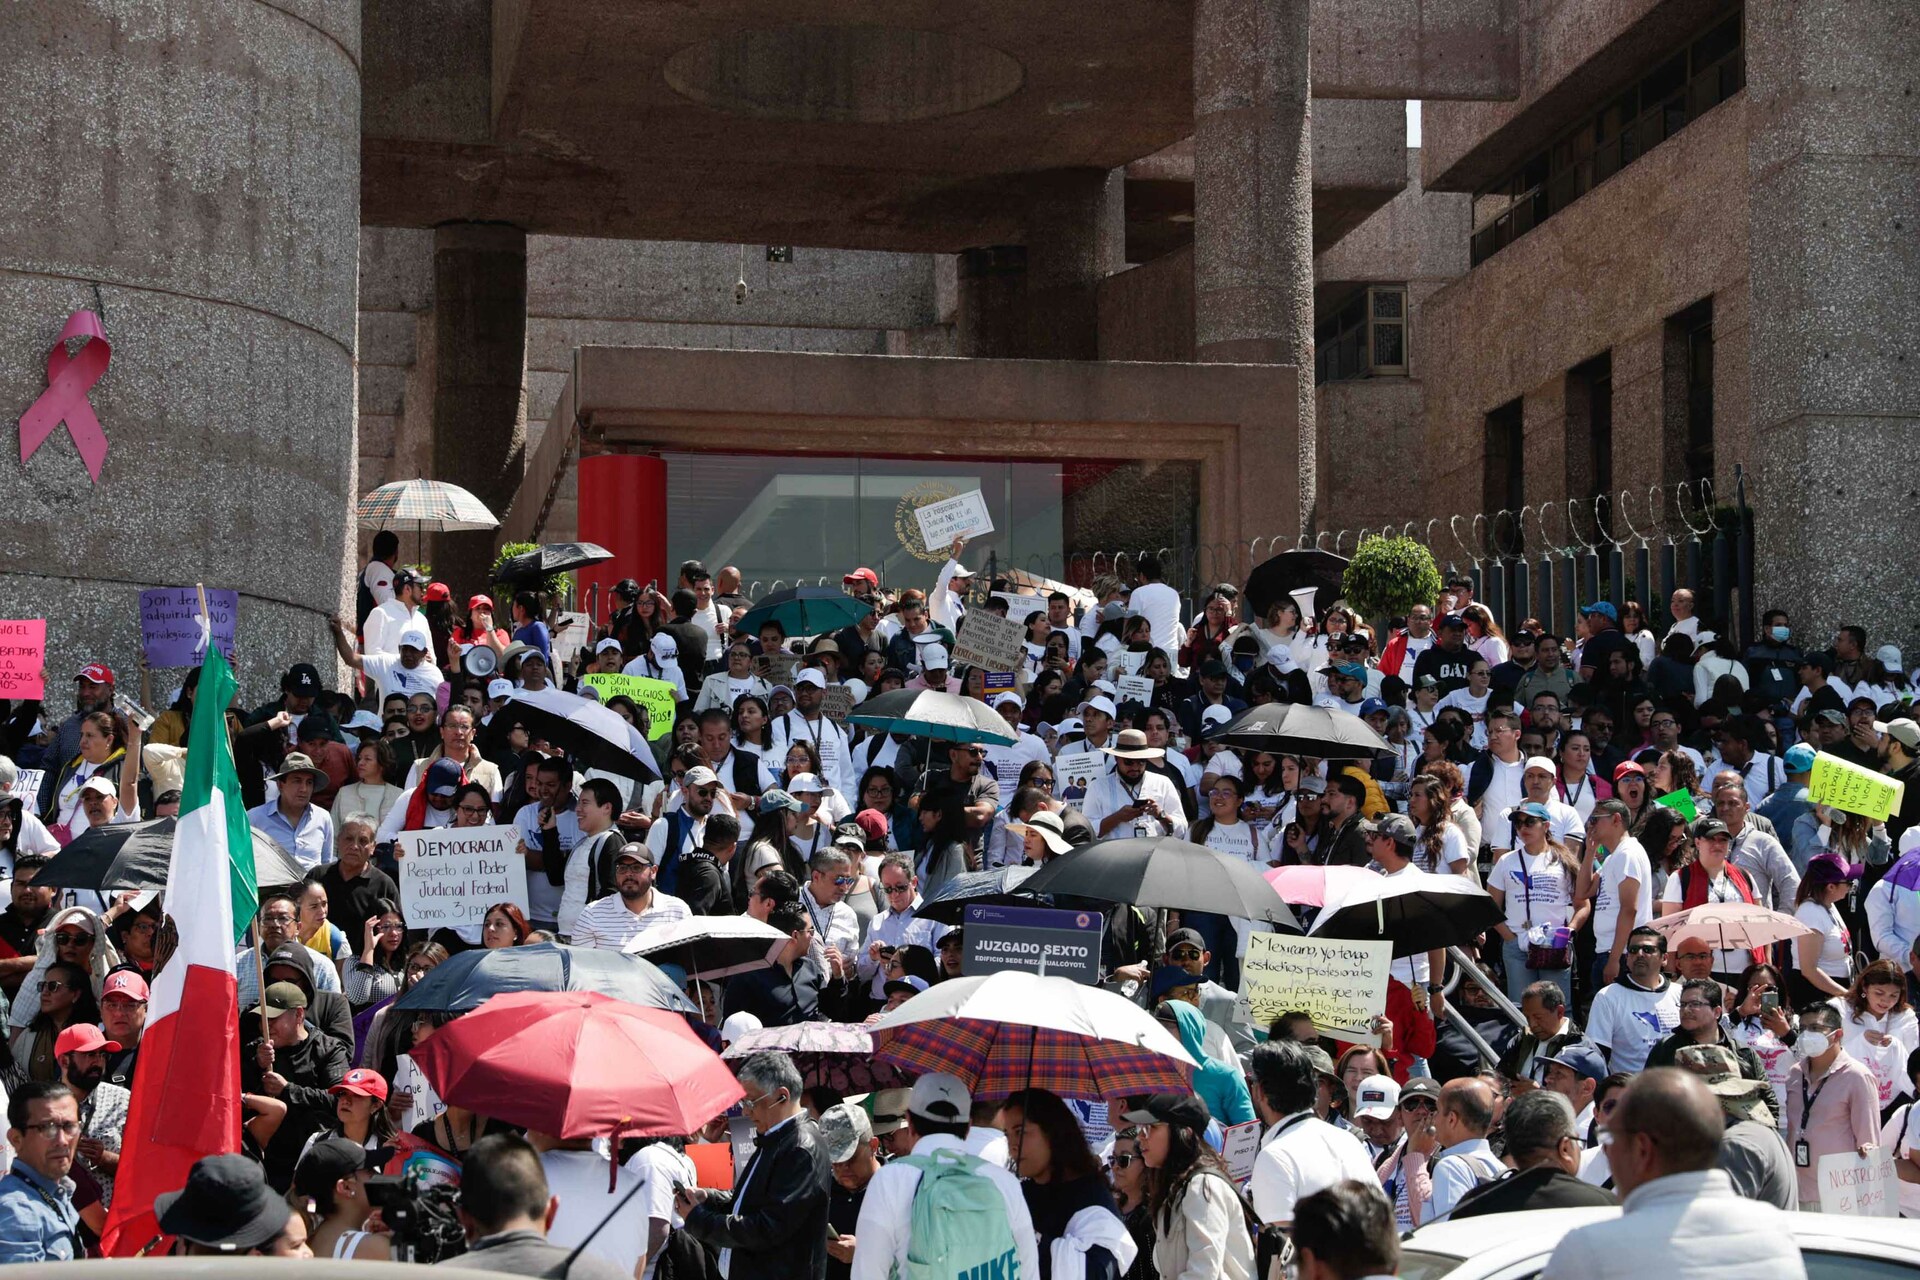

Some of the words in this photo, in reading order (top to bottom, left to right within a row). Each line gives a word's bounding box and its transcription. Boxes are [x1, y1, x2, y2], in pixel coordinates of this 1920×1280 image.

[945, 512, 955, 524] NO
[143, 592, 172, 609] Son
[210, 611, 228, 624] NO
[16, 625, 29, 635] EL
[953, 646, 983, 663] DERECHOS
[301, 673, 311, 685] LA
[591, 676, 606, 685] NO
[610, 675, 630, 686] SON
[416, 838, 504, 857] DEMOCRACIA
[407, 861, 457, 881] Respeto
[462, 861, 473, 875] al
[479, 860, 508, 875] Poder
[419, 880, 465, 898] Judicial
[472, 877, 508, 895] Federal
[452, 902, 465, 918] 3
[975, 939, 1040, 954] JUZGADO
[1043, 943, 1088, 958] SEXTO
[1336, 945, 1369, 967] tengo
[975, 955, 1004, 963] EDIFICIO
[1005, 957, 1023, 965] SEDE
[1246, 959, 1304, 975] estudios
[1307, 963, 1373, 981] profesionales
[1259, 996, 1289, 1007] casa
[1294, 999, 1311, 1008] en
[1278, 985, 1292, 995] un
[1332, 988, 1352, 1003] que
[1356, 988, 1374, 999] me
[1234, 1147, 1249, 1156] PISO
